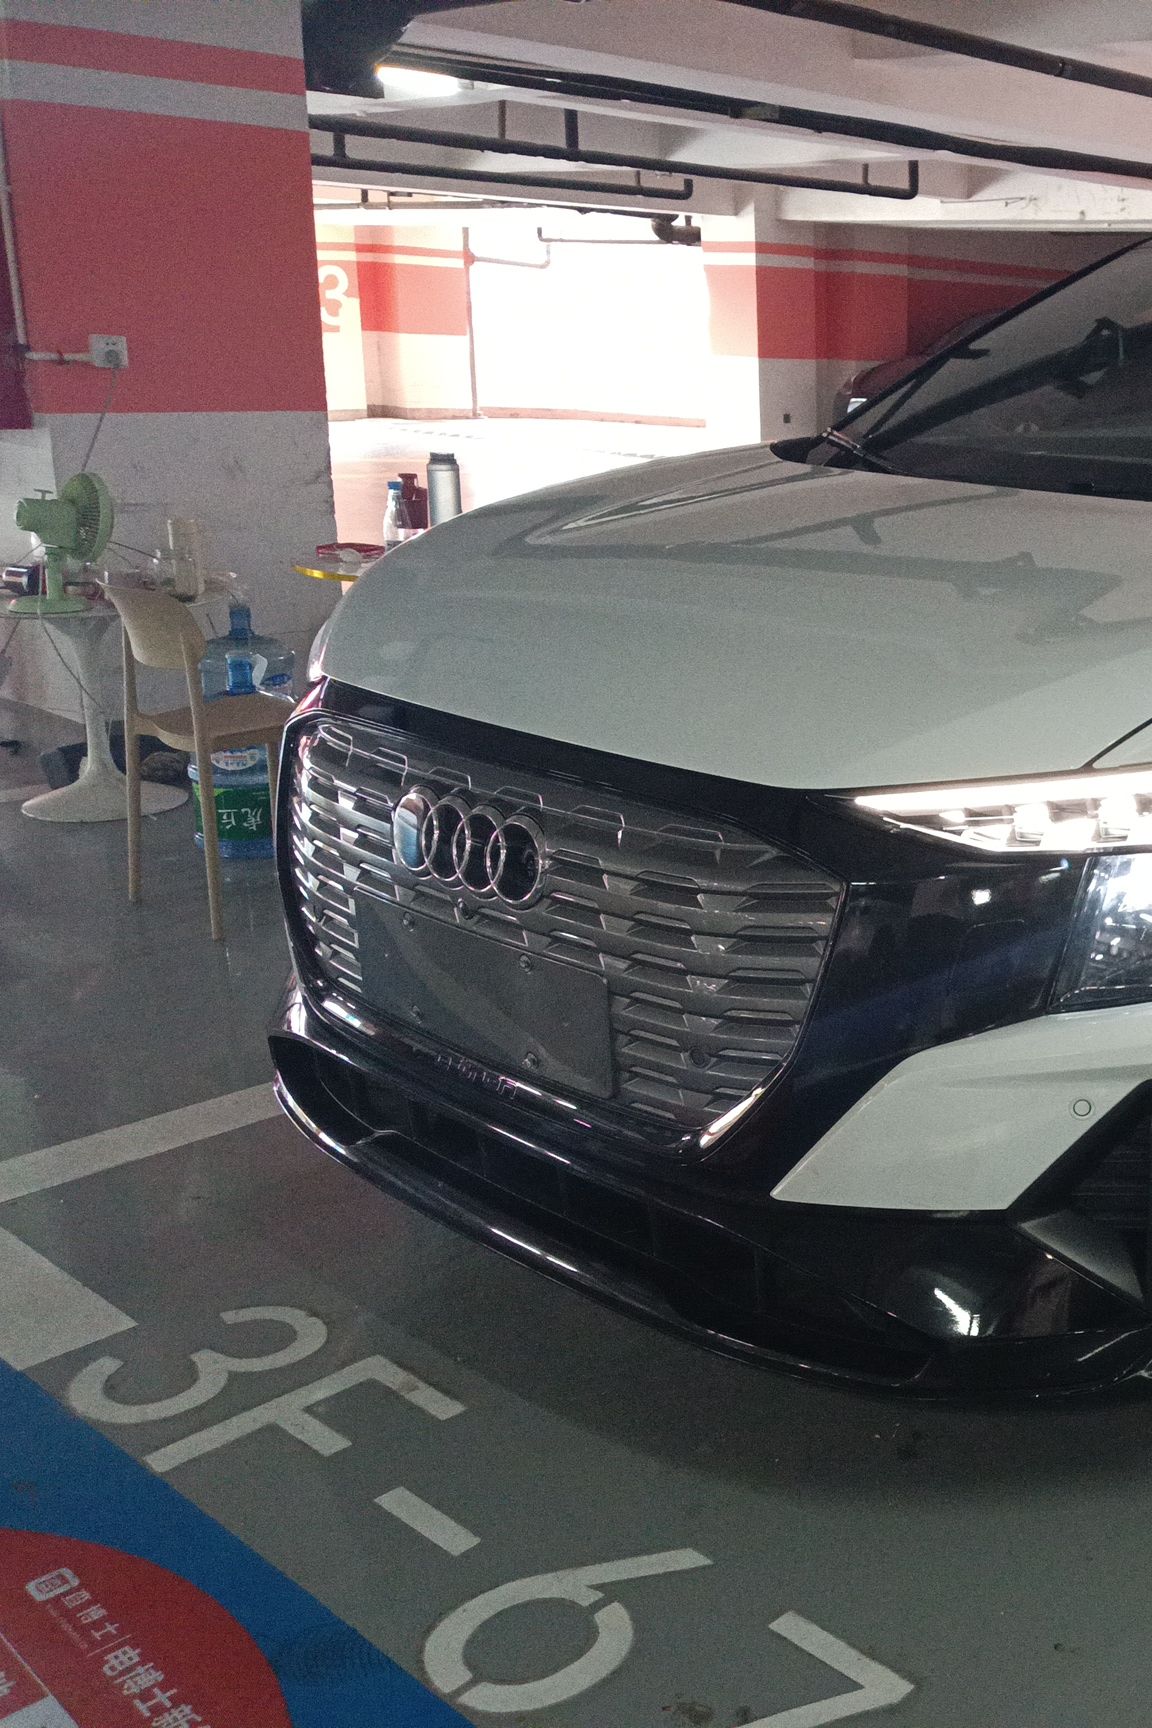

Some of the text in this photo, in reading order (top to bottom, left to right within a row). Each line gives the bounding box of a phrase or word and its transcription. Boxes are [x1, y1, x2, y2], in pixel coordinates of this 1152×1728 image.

[218, 807, 263, 831] 虎丘
[66, 1306, 915, 1728] 3F-67
[102, 1645, 212, 1728] 电博士新
